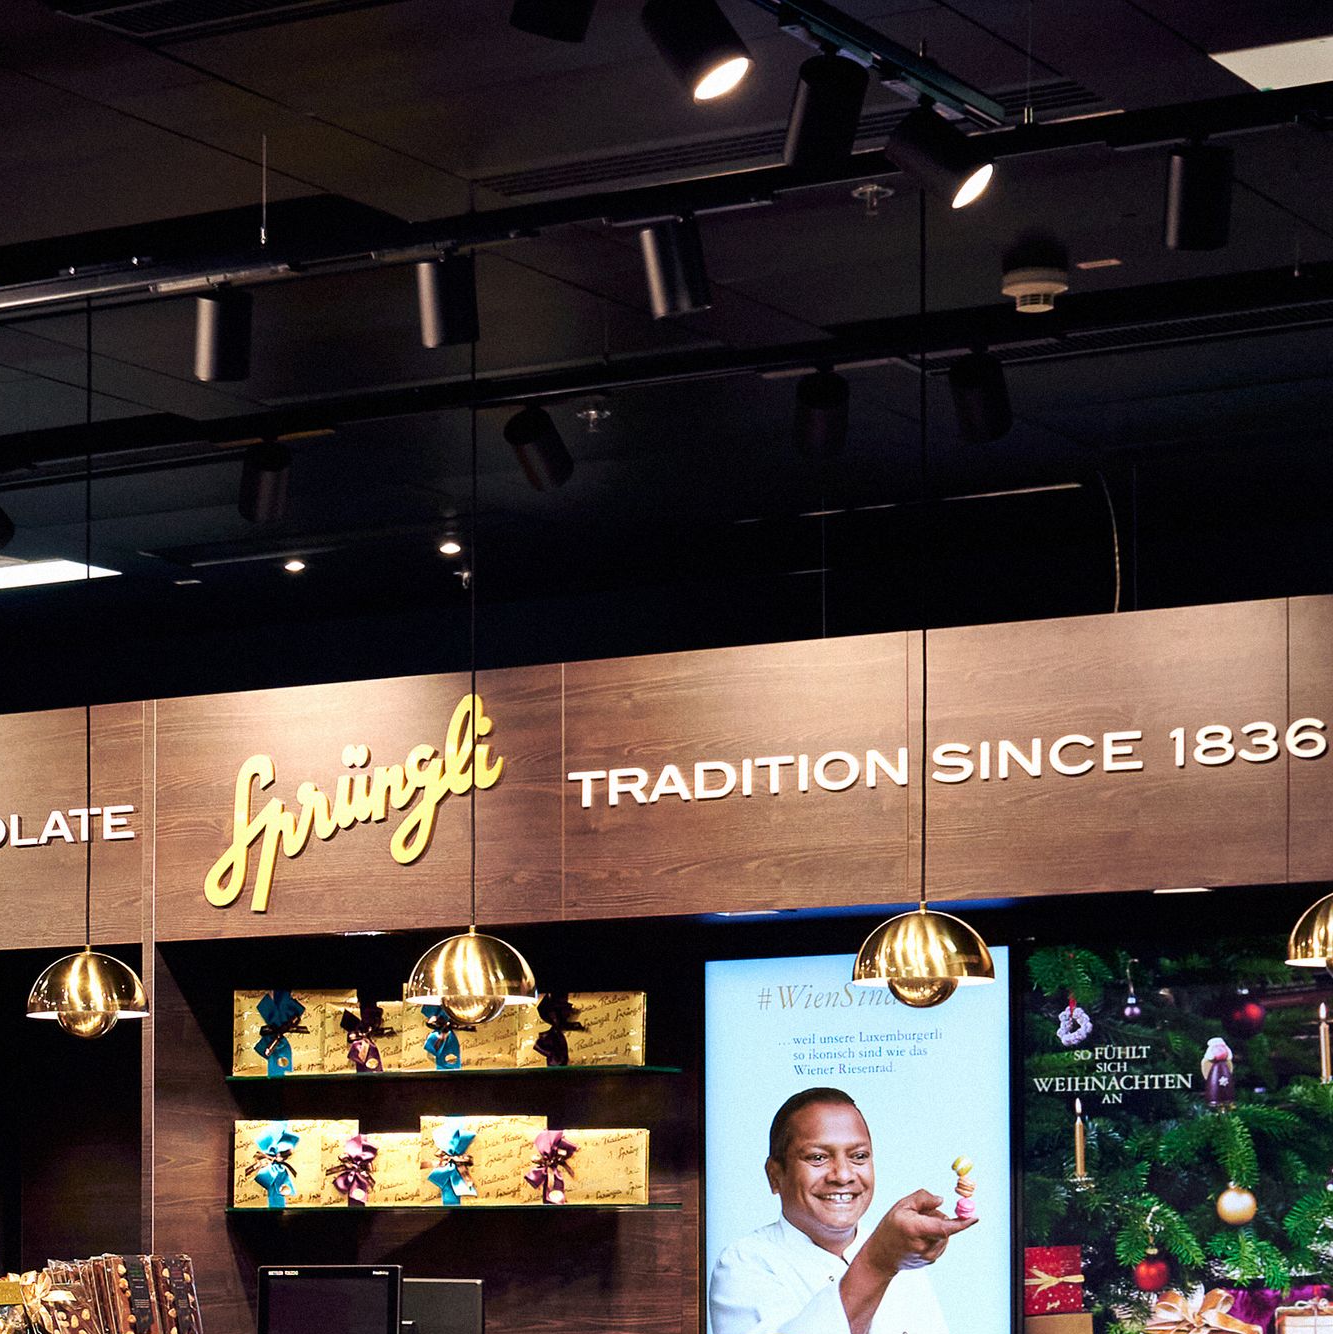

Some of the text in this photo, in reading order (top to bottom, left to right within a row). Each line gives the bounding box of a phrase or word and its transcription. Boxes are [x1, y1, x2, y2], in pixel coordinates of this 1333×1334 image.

[568, 717, 1329, 808] TRADITION SINCE 1836
[204, 693, 505, 912] Sprüngli
[819, 1035, 856, 1044] unsere
[859, 1028, 943, 1043] Luxemburgerli
[793, 1045, 928, 1061] so ikonisch sind wie das
[1073, 1044, 1151, 1061] SO FÜHLT
[794, 1063, 834, 1076] Wiener
[1095, 1061, 1128, 1073] SICH
[1033, 1073, 1193, 1093] WEIHNACHTEN
[1101, 1093, 1123, 1104] AN
